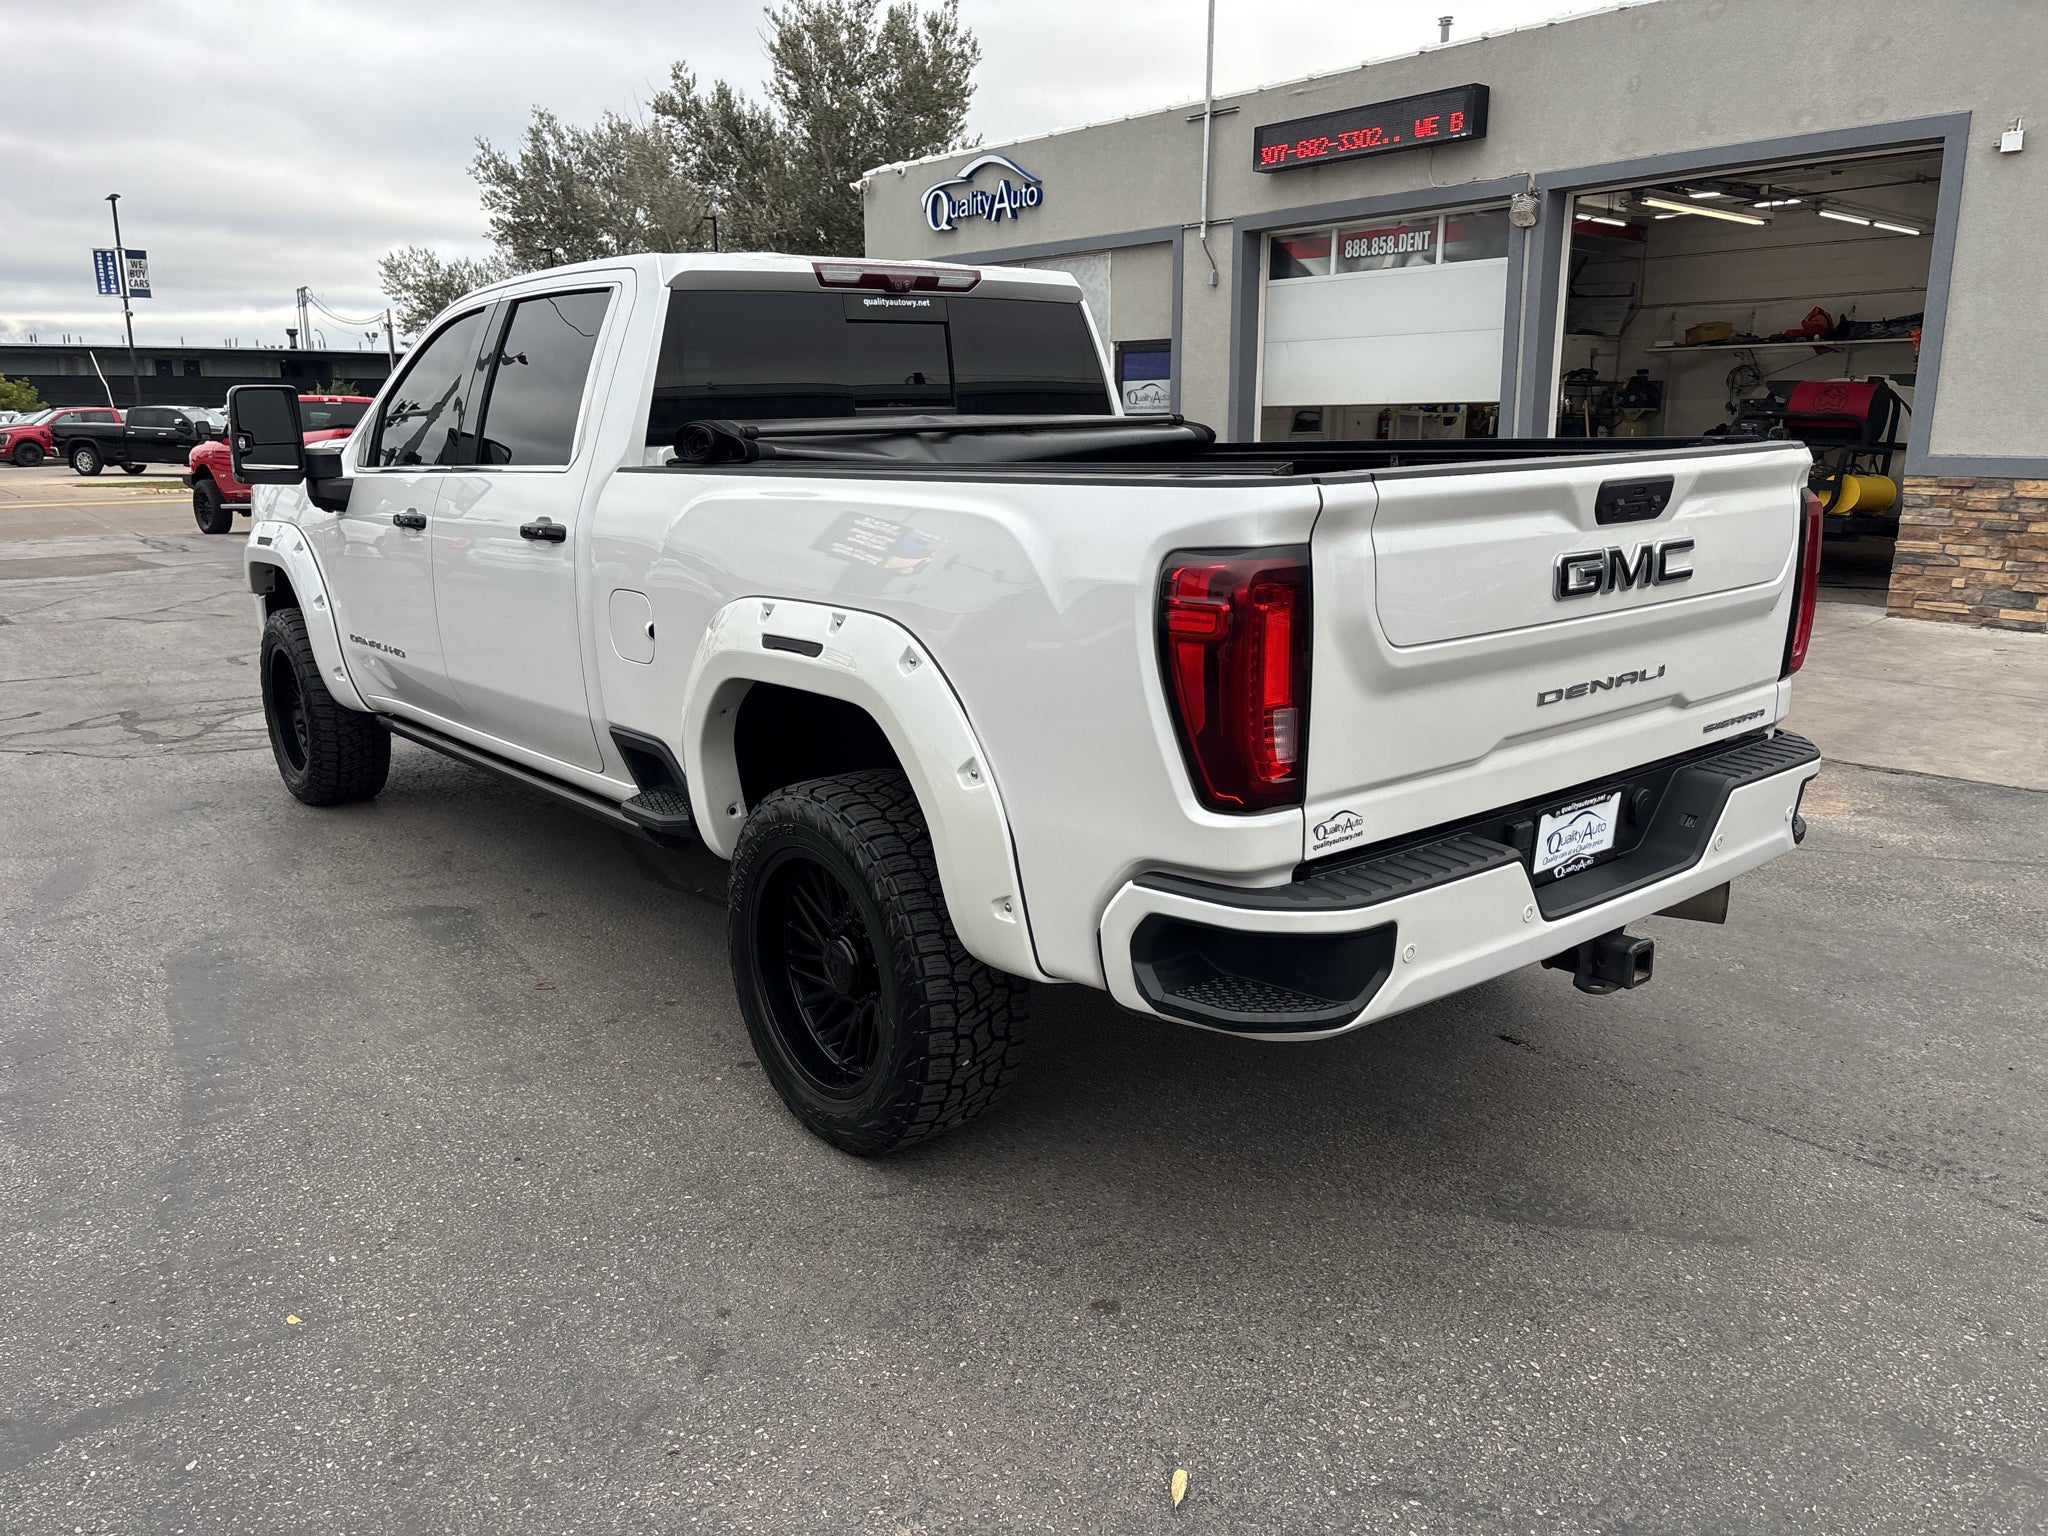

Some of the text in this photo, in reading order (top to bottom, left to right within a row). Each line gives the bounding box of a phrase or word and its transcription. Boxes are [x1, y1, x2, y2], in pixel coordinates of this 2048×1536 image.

[1414, 115, 1440, 138] WE
[1449, 111, 1464, 133] B
[1344, 230, 1431, 259] 888.858.DENT
[129, 269, 146, 279] BUY
[130, 260, 144, 269] WE
[129, 279, 150, 288] CARS
[863, 297, 931, 307] qualityautowy.net
[1552, 536, 1695, 601] GMC
[1536, 663, 1666, 707] DENALI
[1702, 708, 1766, 734] SIERRA
[1312, 830, 1364, 851] qualityautowy.net
